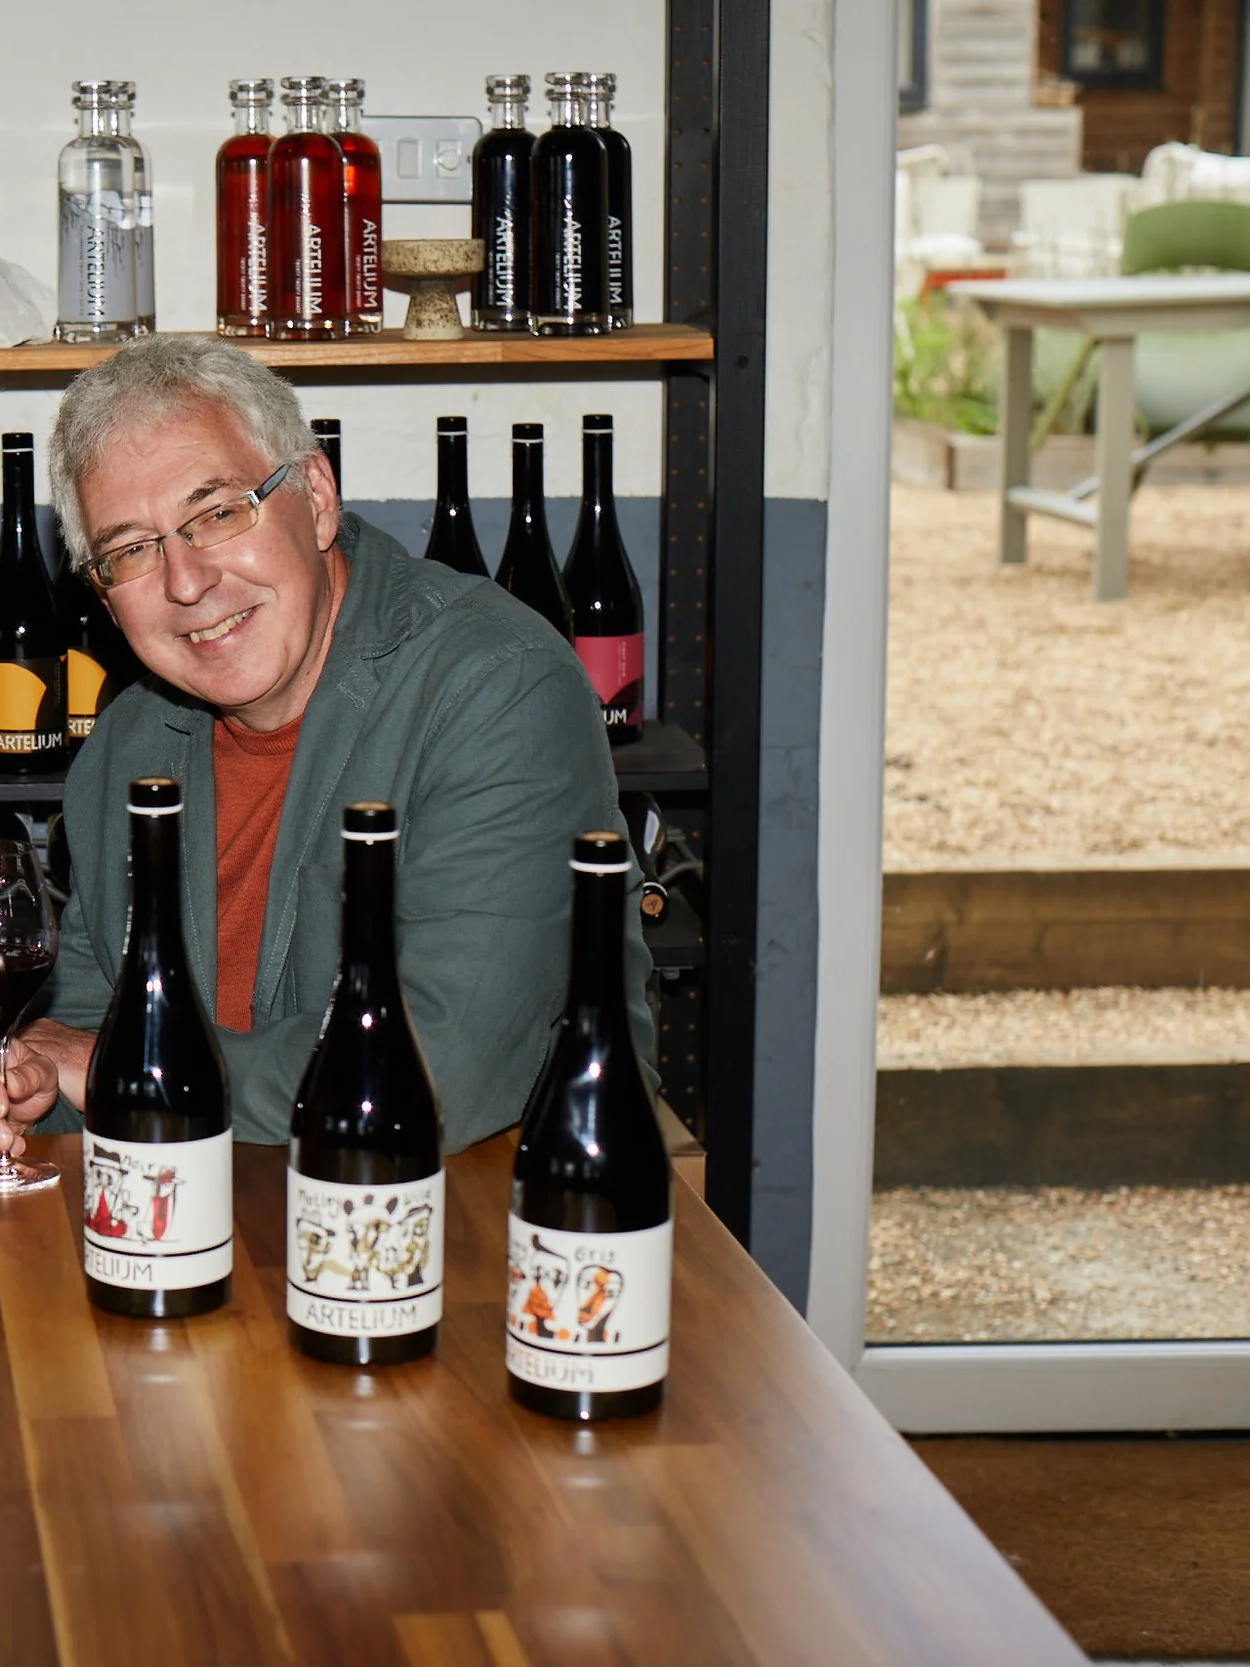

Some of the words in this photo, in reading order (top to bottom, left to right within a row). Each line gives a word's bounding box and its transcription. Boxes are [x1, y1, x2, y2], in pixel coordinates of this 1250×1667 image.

[87, 225, 105, 316] ARTELIUM
[362, 218, 378, 308] ARTELIUM
[496, 216, 513, 307] ARTELIUM
[305, 1303, 417, 1330] ARTELIUM
